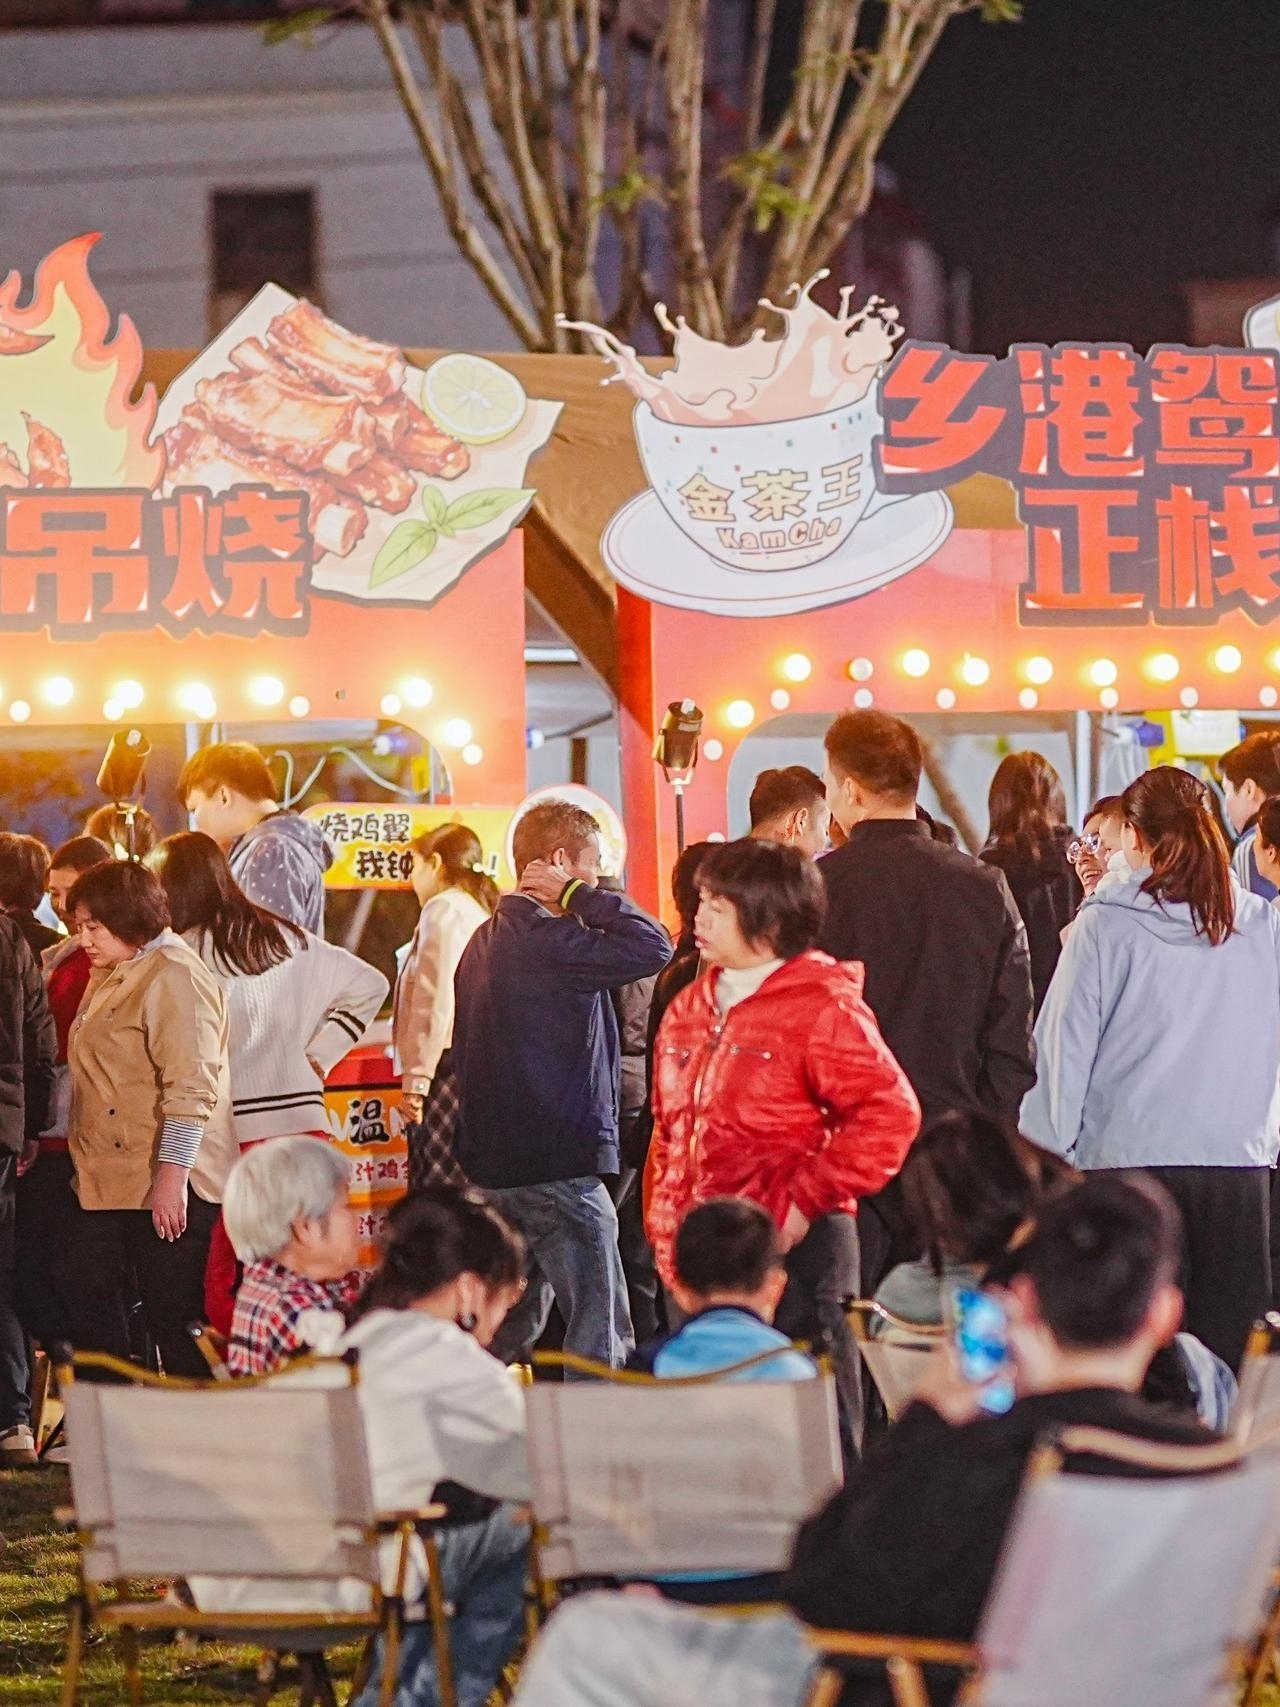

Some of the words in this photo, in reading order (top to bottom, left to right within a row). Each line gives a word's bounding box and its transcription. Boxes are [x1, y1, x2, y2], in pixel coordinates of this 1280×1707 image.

[677, 454, 863, 522] 金茶王
[0, 491, 306, 624] 吊烧
[716, 517, 842, 549] KamCha
